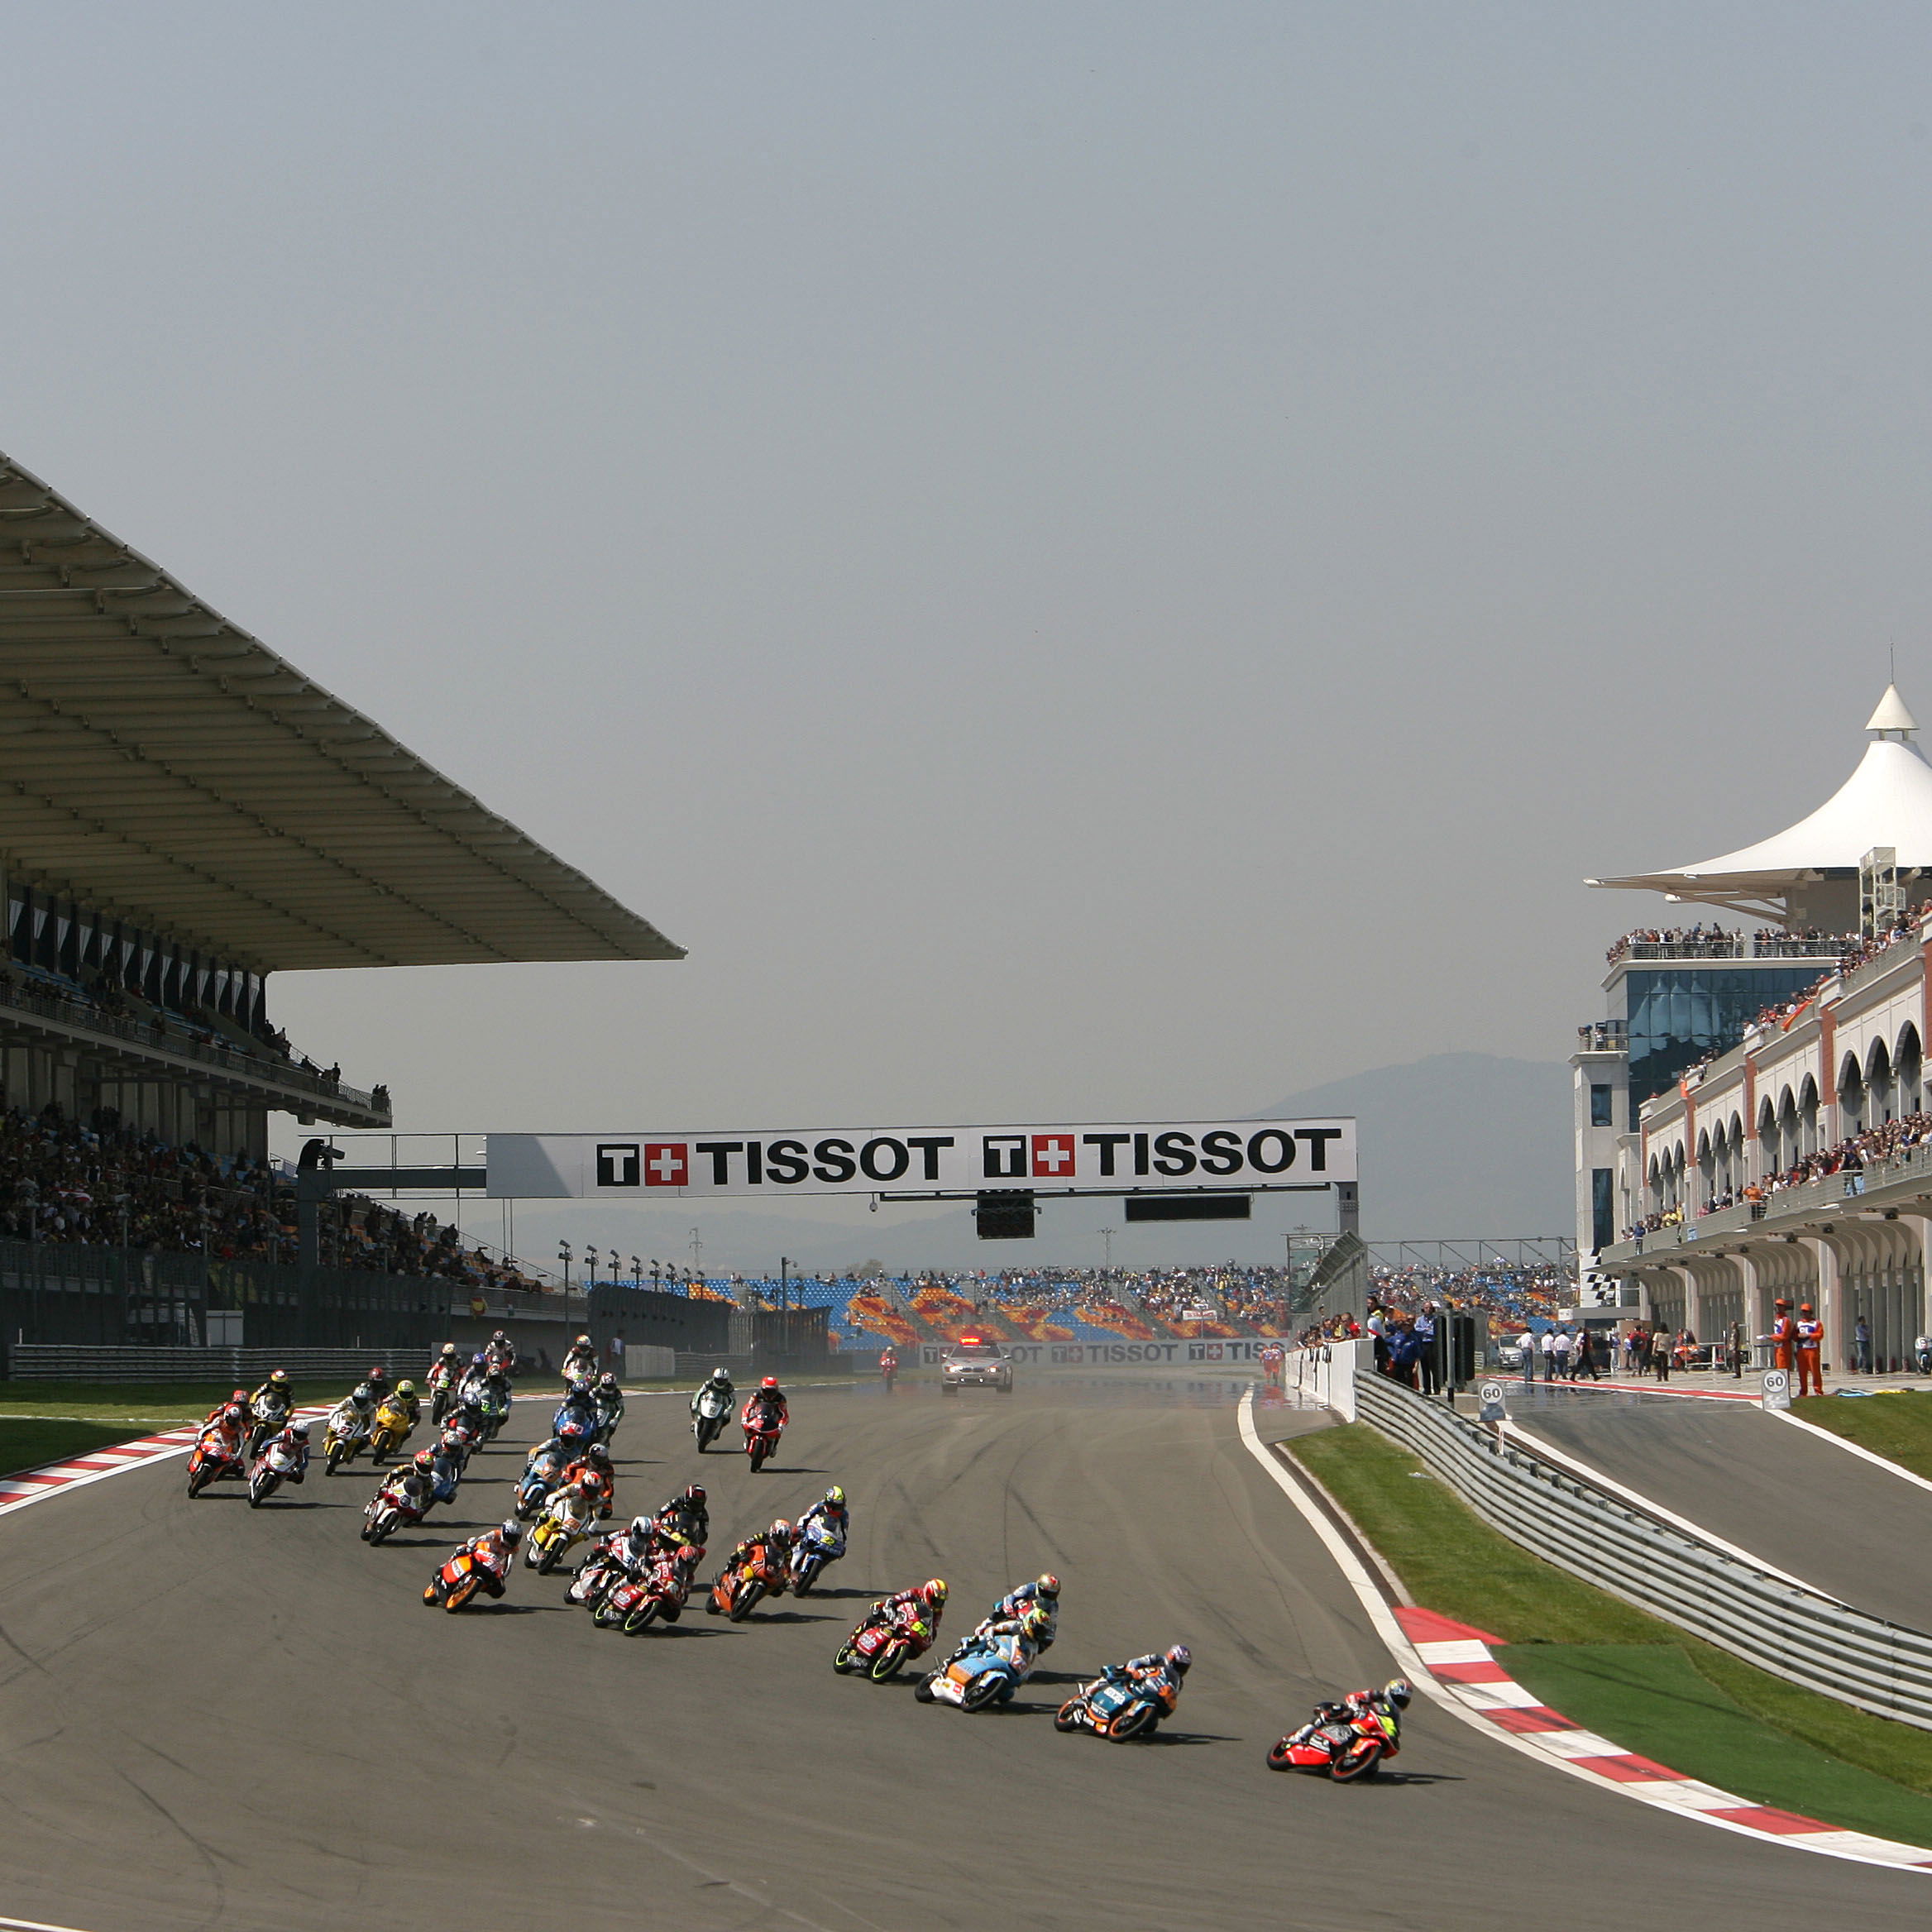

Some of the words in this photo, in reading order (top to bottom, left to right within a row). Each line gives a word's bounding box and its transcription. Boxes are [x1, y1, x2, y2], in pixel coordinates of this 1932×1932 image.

[696, 1131, 954, 1185] TISSOT
[1083, 1128, 1341, 1176] TISSOT
[1087, 1343, 1179, 1363] TISSOT
[1766, 1376, 1784, 1387] 60
[1483, 1388, 1500, 1399] 60
